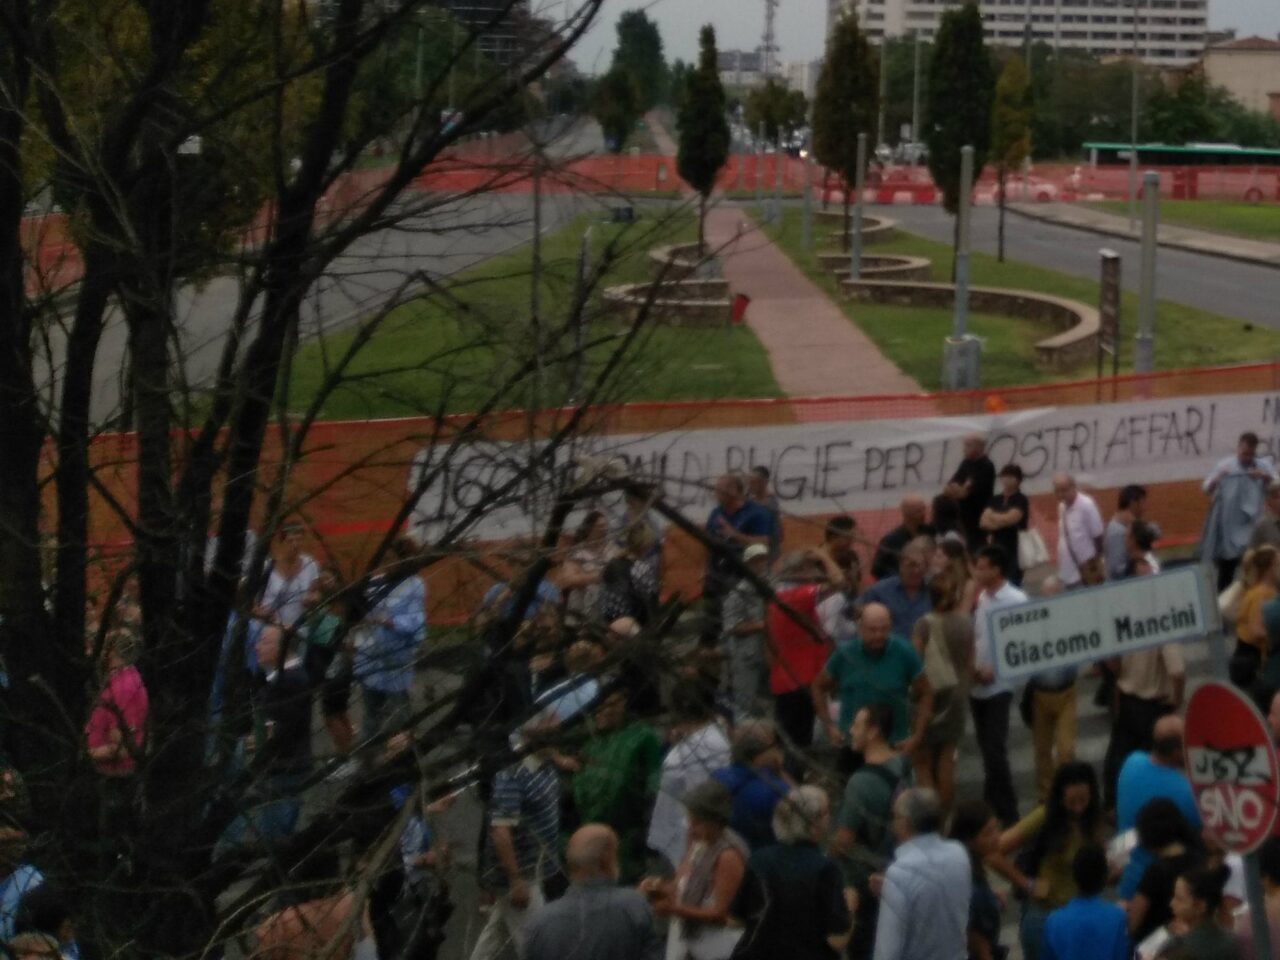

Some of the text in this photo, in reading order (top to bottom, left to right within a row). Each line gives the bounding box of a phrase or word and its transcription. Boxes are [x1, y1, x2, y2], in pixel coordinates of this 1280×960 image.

[864, 442, 924, 490] PER
[987, 420, 1098, 479] OSTRI
[1104, 404, 1216, 464] AFFARI
[999, 607, 1050, 631] piazza
[1005, 603, 1196, 668] Giacomo Mancini
